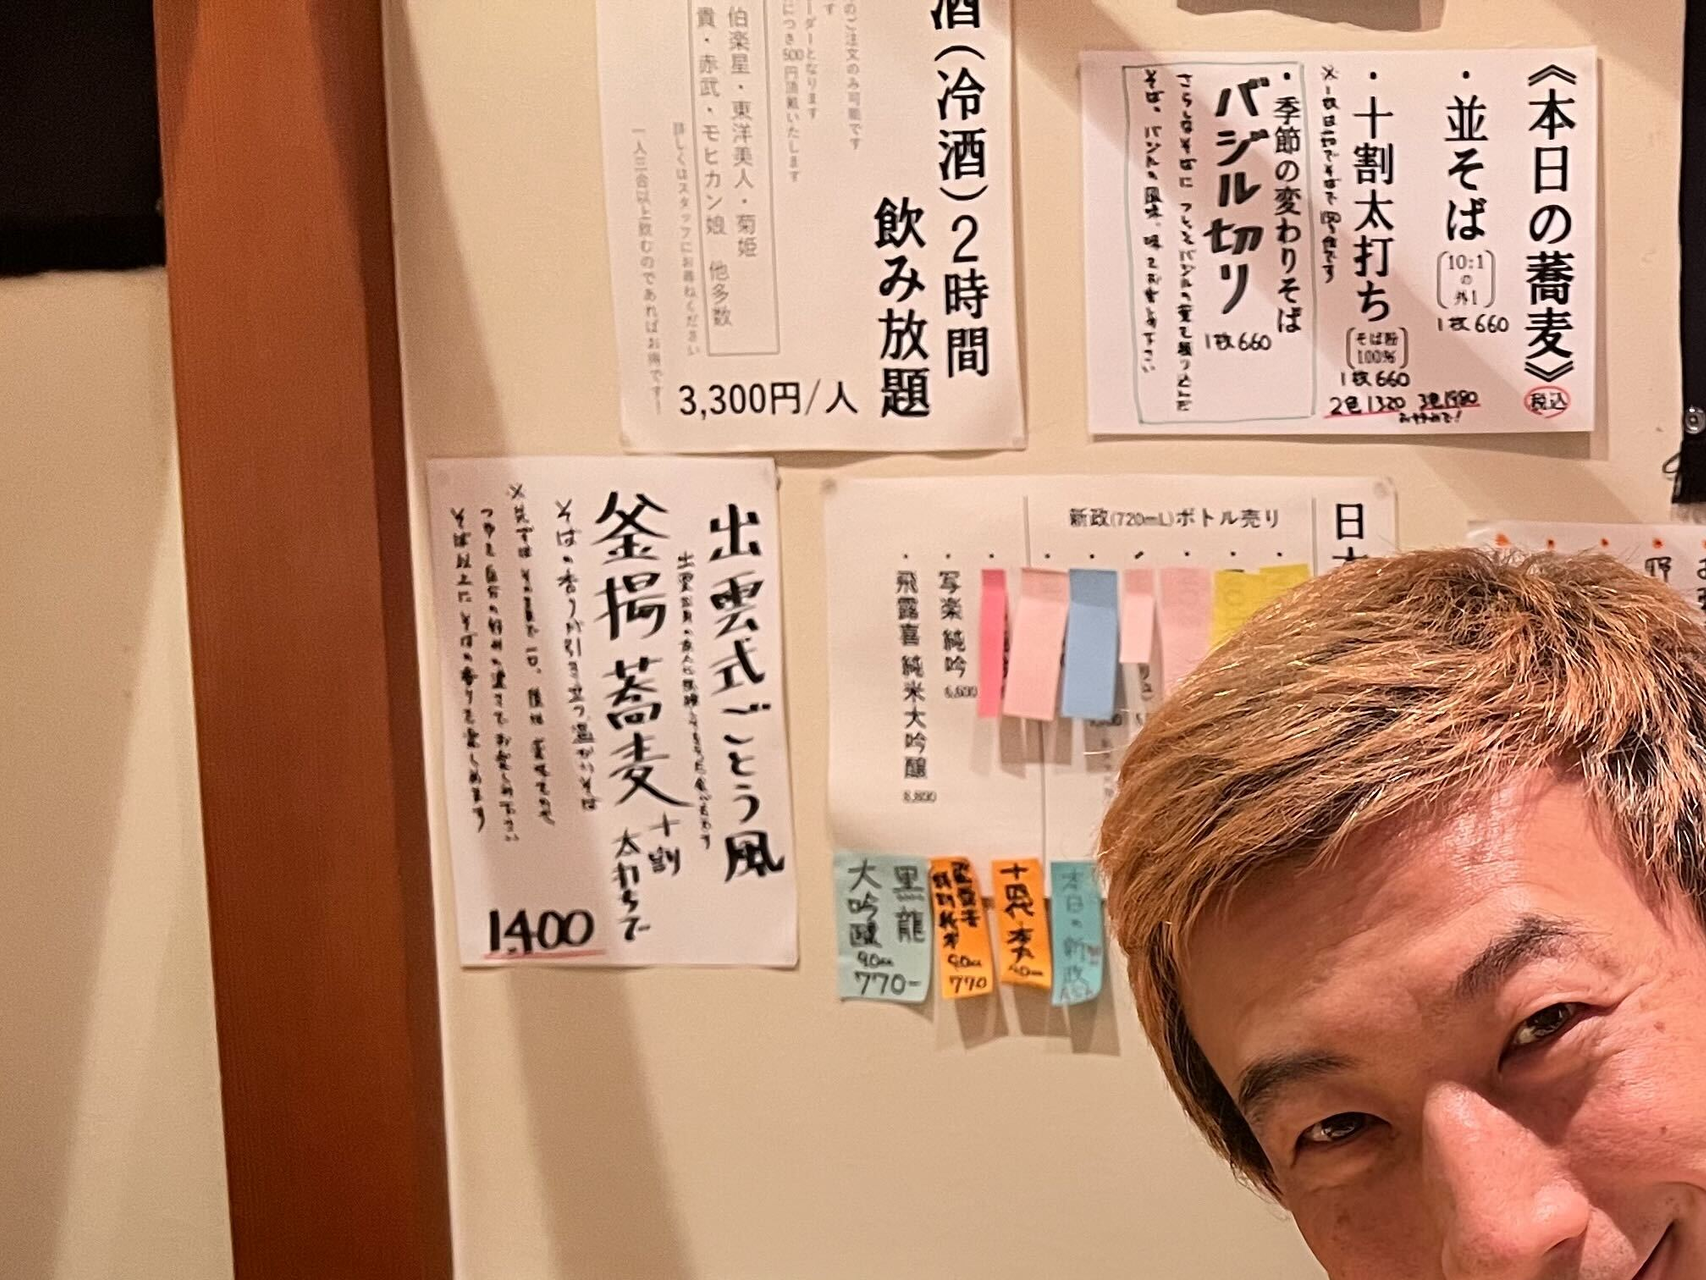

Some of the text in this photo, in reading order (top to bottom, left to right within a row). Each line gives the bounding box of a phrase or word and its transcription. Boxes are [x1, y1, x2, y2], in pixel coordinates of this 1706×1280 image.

[1203, 76, 1270, 315] バジル切り
[1273, 96, 1303, 334] 季節の変わりそば
[1353, 96, 1395, 323] 十割太打ち
[1445, 95, 1489, 240] 並そば
[679, 379, 859, 420] 3,300円/人
[874, 196, 931, 418] 飲み放題
